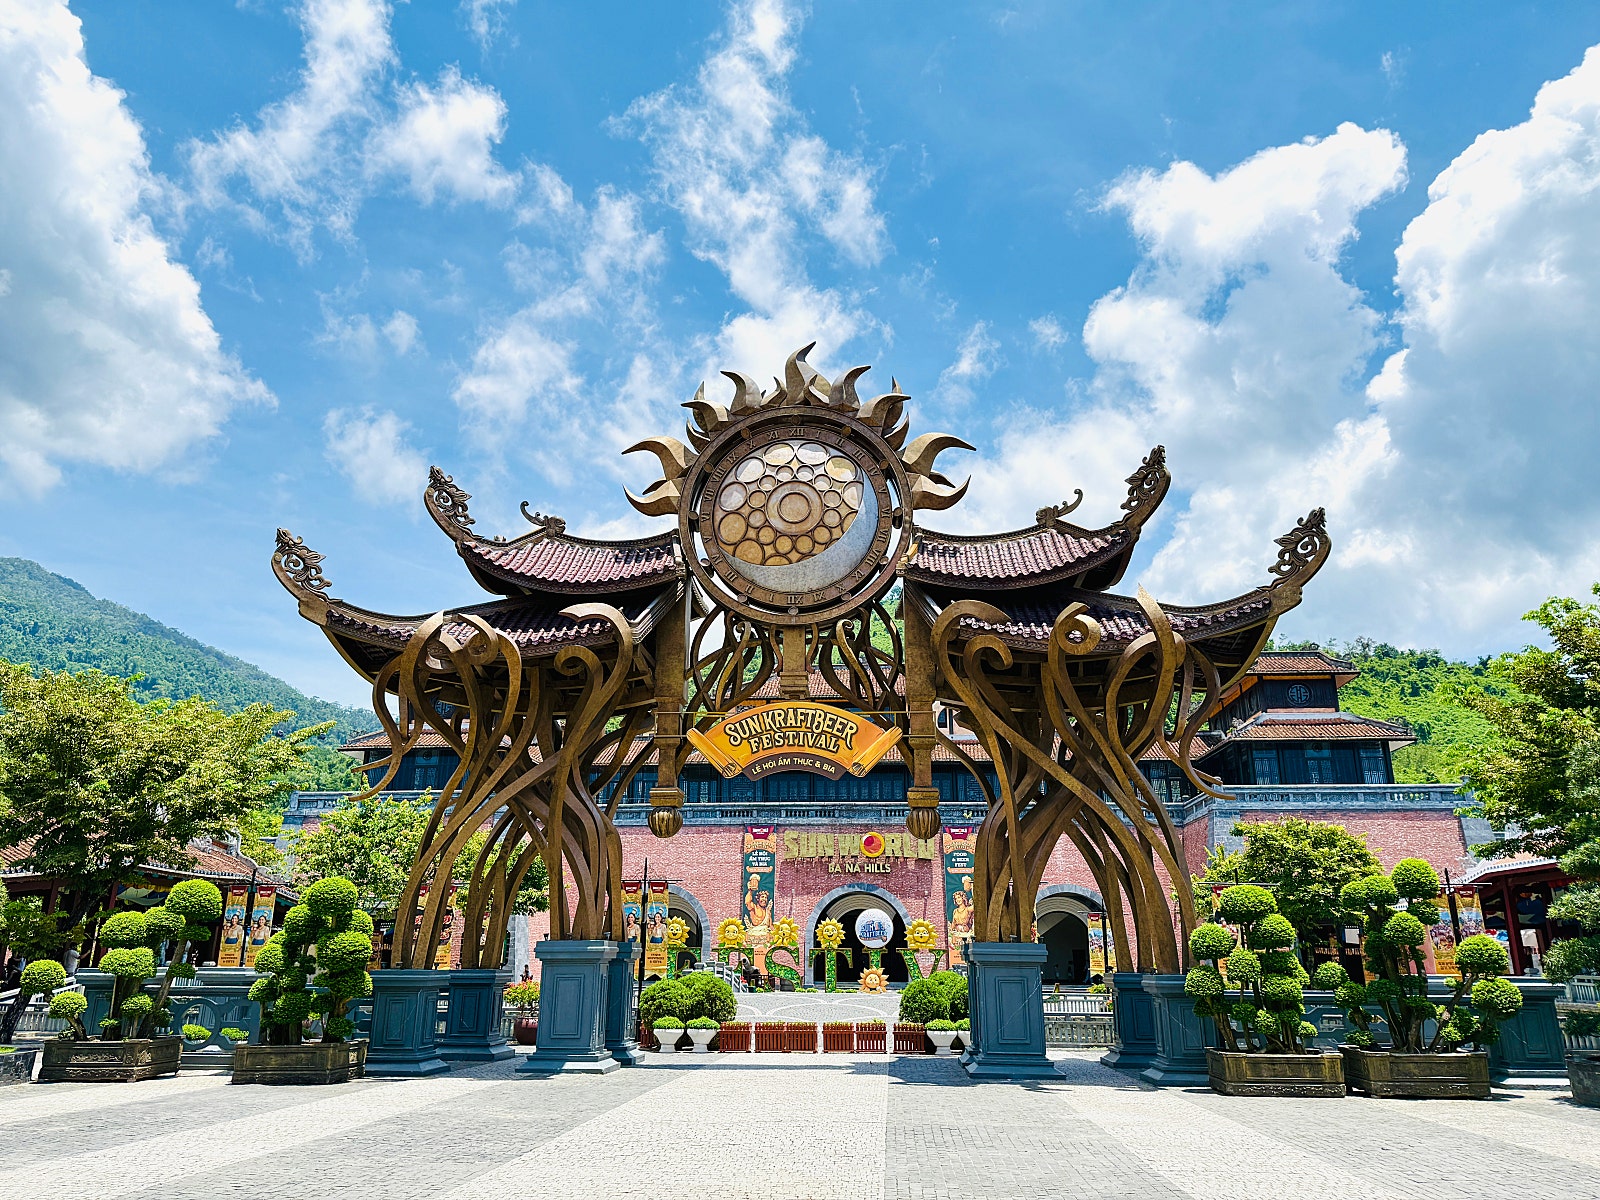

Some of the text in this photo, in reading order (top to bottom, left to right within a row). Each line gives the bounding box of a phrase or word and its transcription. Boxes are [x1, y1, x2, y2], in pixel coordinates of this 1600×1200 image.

[725, 708, 857, 749] SUN KRAFTBEER
[749, 732, 840, 752] FESTIVAL
[762, 760, 776, 771] HỘI
[793, 758, 813, 768] THỰC
[822, 764, 836, 773] BIA
[828, 863, 891, 873] BA NA HILLS
